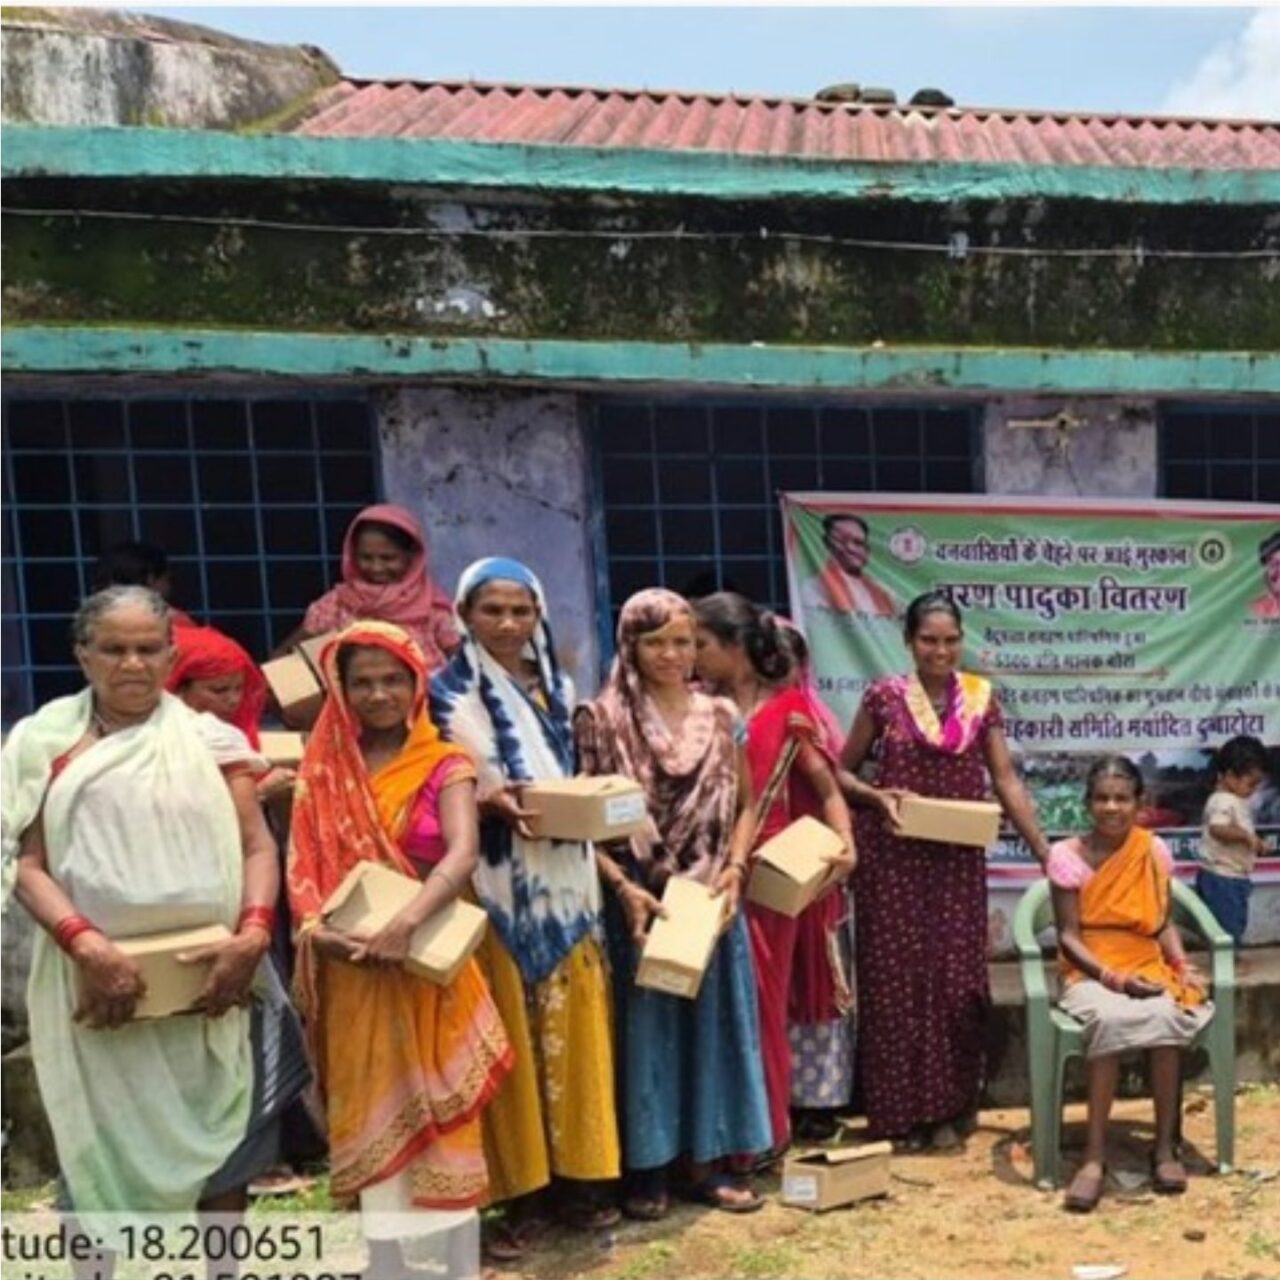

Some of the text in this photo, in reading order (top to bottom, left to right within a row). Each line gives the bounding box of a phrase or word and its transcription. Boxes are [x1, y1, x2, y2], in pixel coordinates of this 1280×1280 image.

[936, 537, 1018, 563] वनवासियों
[1022, 538, 1037, 563] के
[1078, 546, 1097, 564] पर
[1005, 585, 1090, 618] पादुका
[1100, 576, 1187, 610] वितरण
[1069, 711, 1122, 738] समिति
